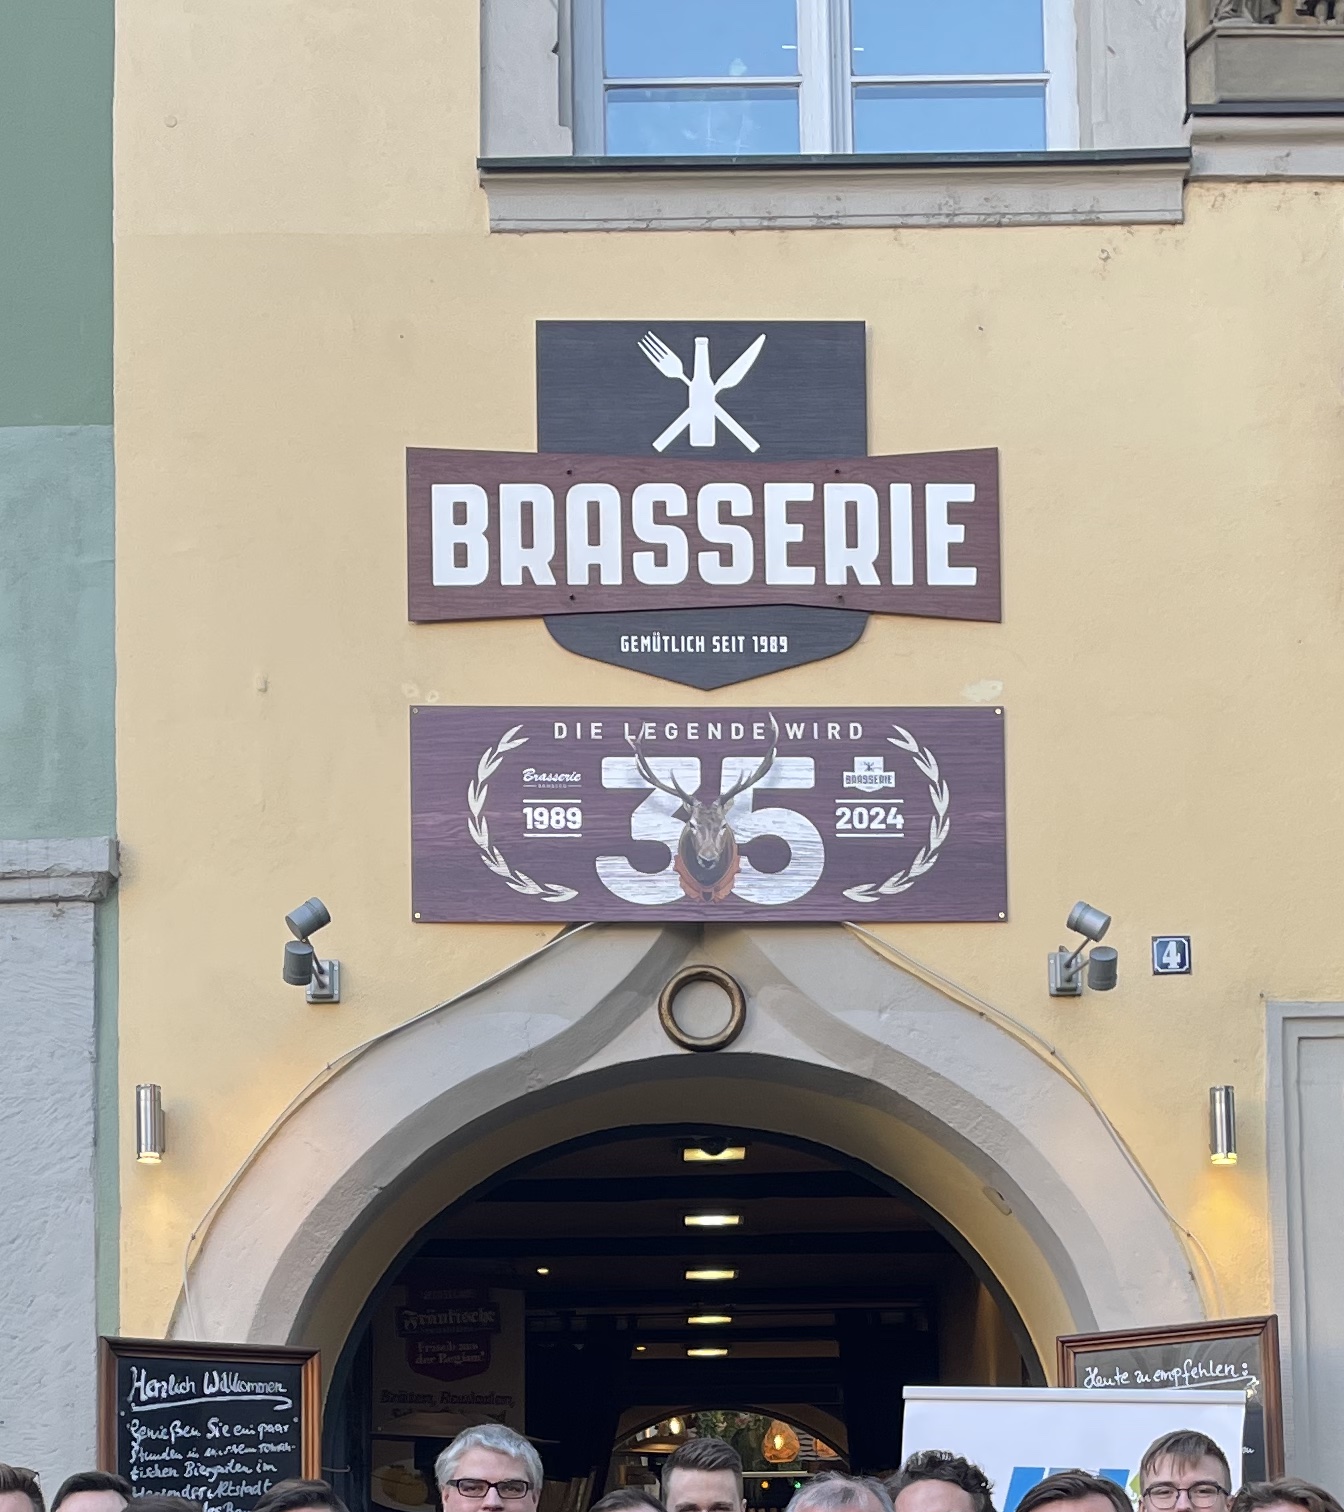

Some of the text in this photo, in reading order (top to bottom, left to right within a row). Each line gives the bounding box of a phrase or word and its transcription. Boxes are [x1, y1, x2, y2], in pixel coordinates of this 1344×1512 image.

[431, 483, 977, 586] BRASSERIE
[621, 631, 788, 653] GEMÜTLICH SEIT 1989
[553, 722, 863, 740] DIE LEGENDE WIRD
[522, 767, 582, 782] Brasserie
[845, 774, 894, 785] BRASSERIE
[522, 806, 582, 830] 1989
[835, 806, 905, 830] 2024
[595, 756, 825, 905] 35
[1162, 941, 1181, 969] 4
[127, 1366, 288, 1402] Herzlich Willkommen
[1083, 1366, 1131, 1389] Heute
[205, 1416, 232, 1440] Sie
[183, 1458, 253, 1483] Biergarten
